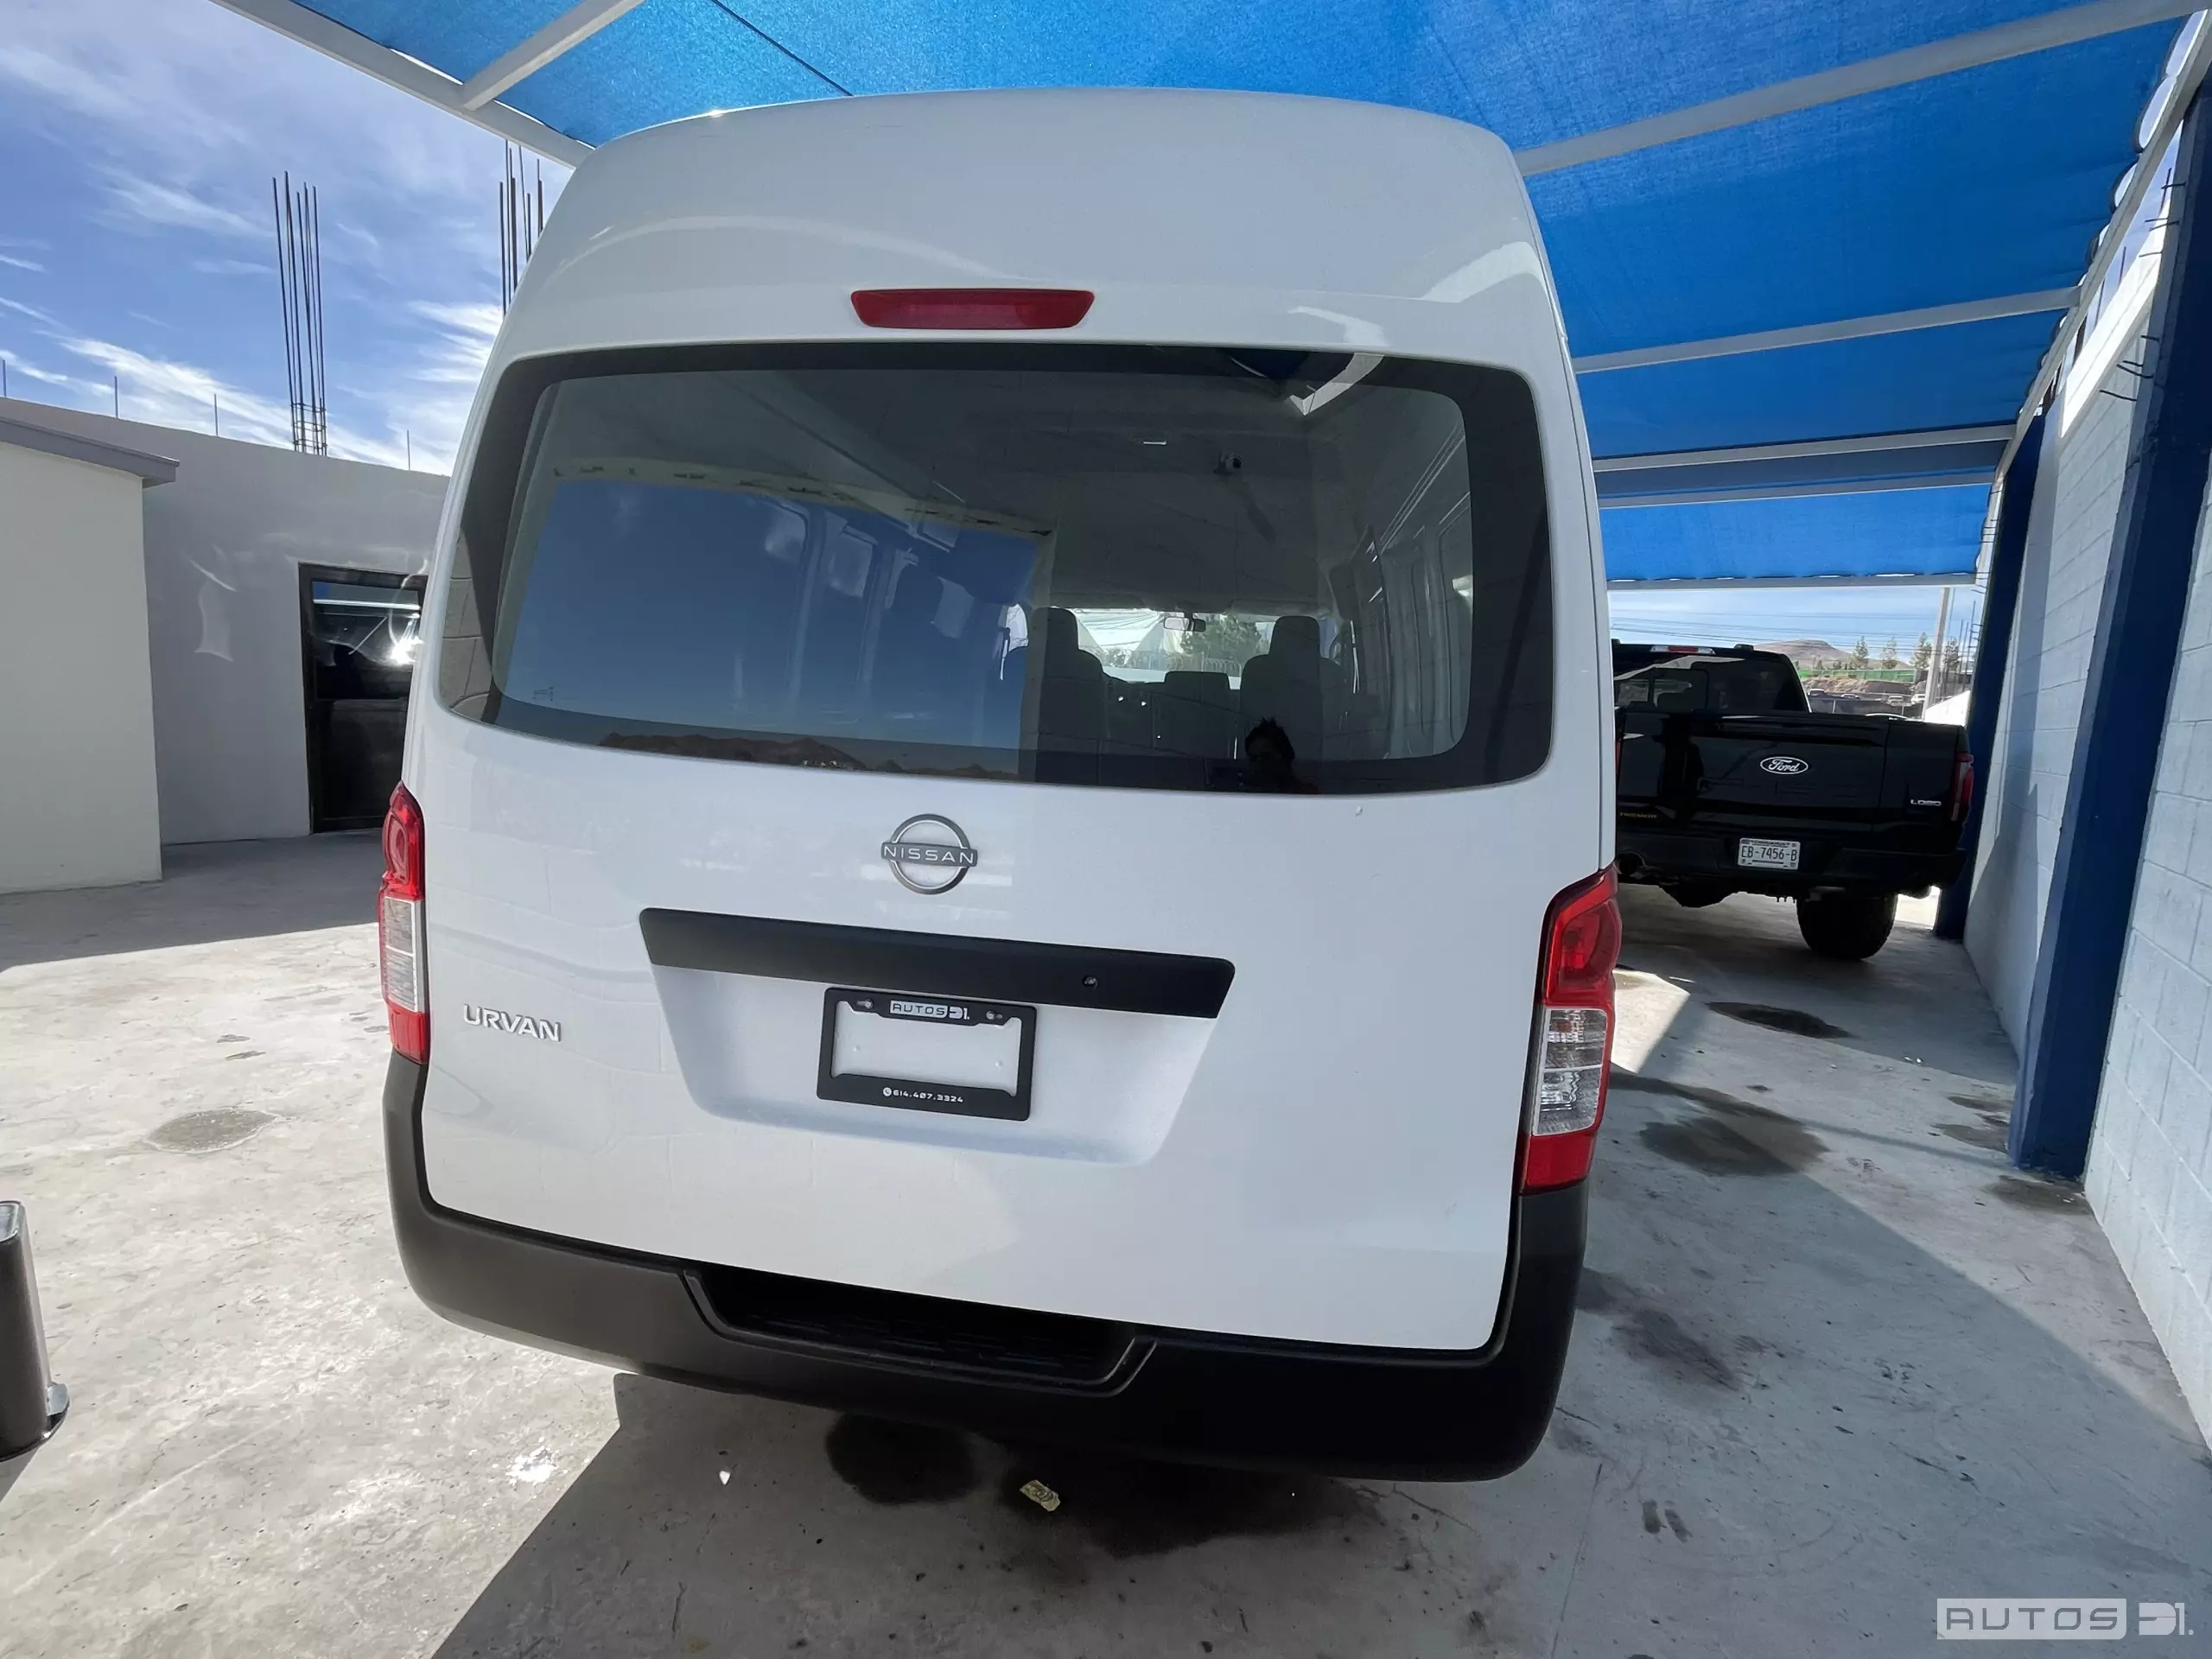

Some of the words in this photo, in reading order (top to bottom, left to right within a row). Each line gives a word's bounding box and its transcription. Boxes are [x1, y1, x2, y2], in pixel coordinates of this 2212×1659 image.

[1768, 759, 1800, 772] Ford
[884, 845, 974, 864] NISSAN
[1741, 845, 1797, 861] EB-7456-B
[893, 1003, 945, 1015] AUTOS
[463, 1003, 562, 1042] URVAN
